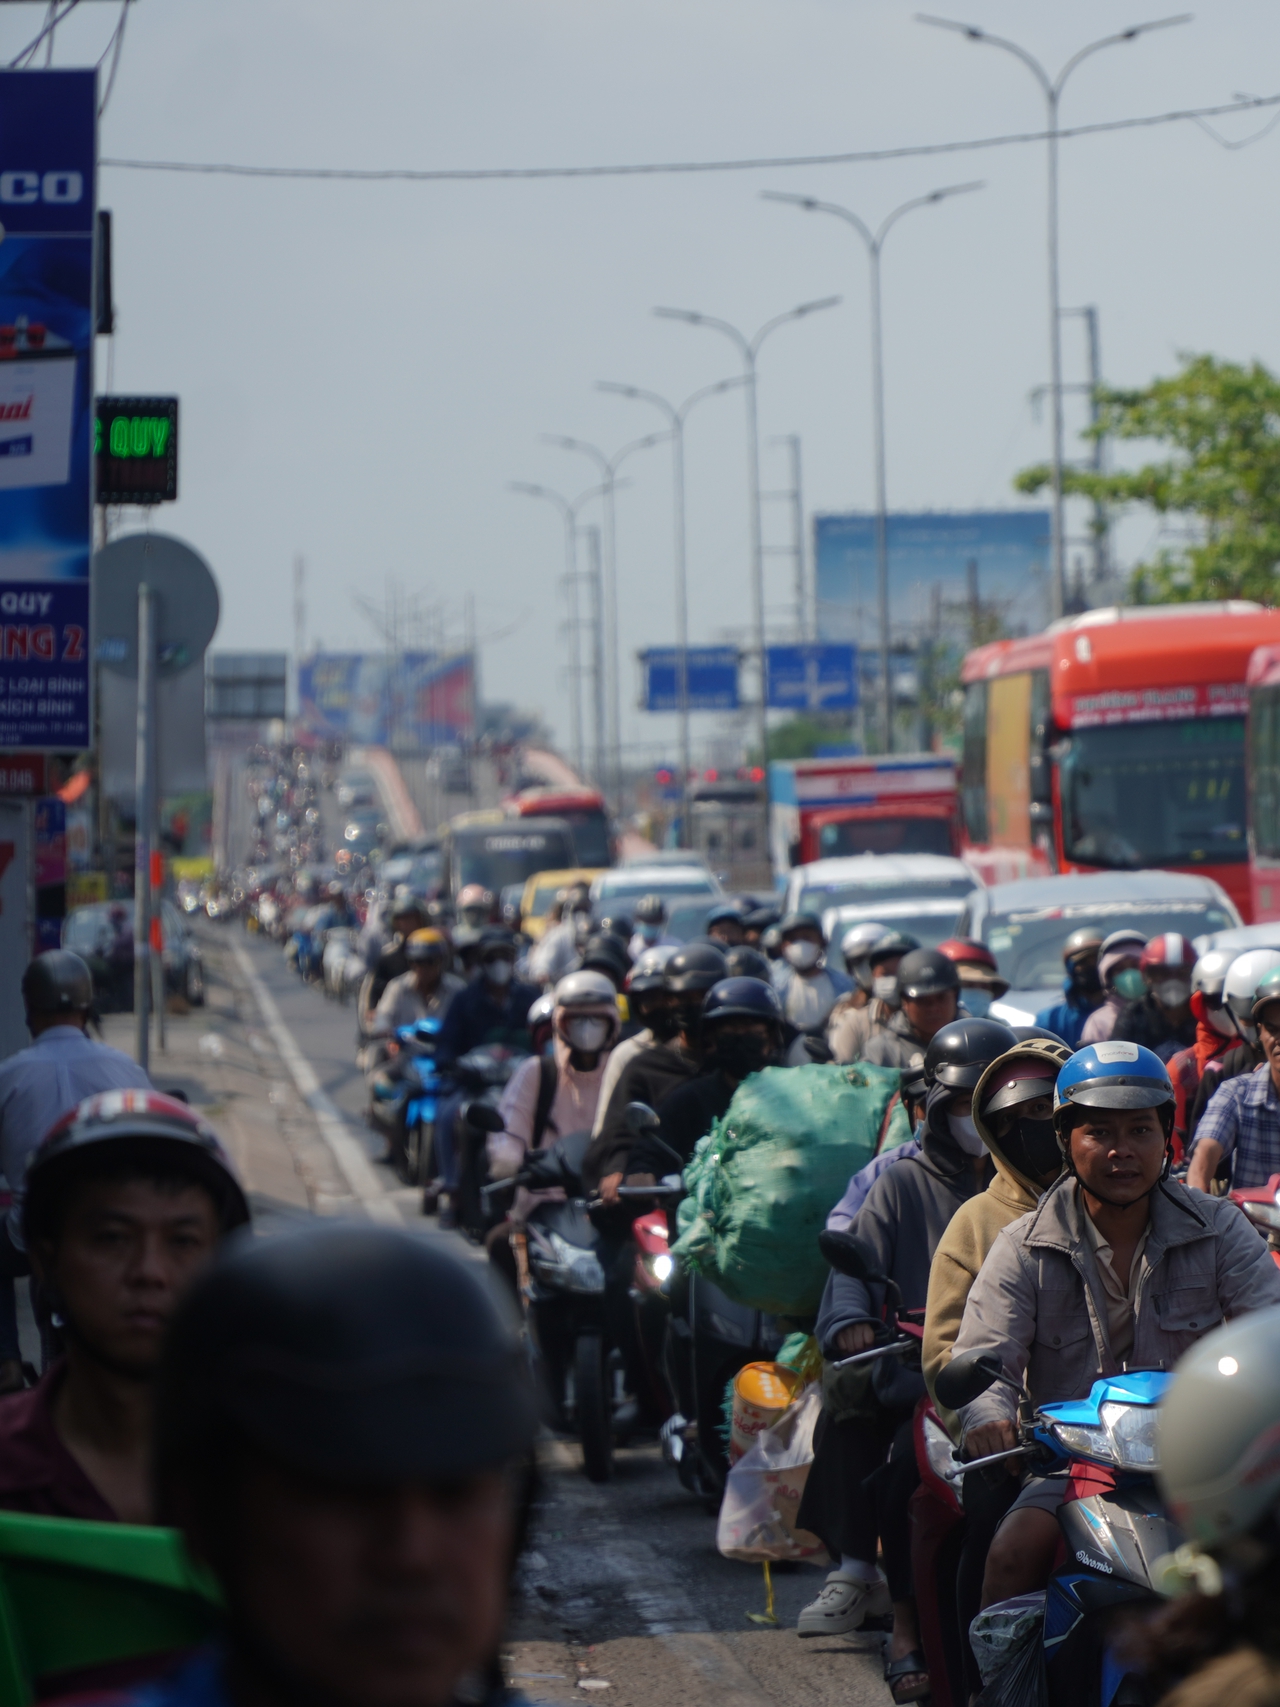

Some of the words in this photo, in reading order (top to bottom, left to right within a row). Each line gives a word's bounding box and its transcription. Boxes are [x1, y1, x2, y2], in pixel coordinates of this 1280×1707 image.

[109, 416, 170, 459] QUY
[62, 624, 84, 661] 2
[1081, 1553, 1113, 1575] brembo
